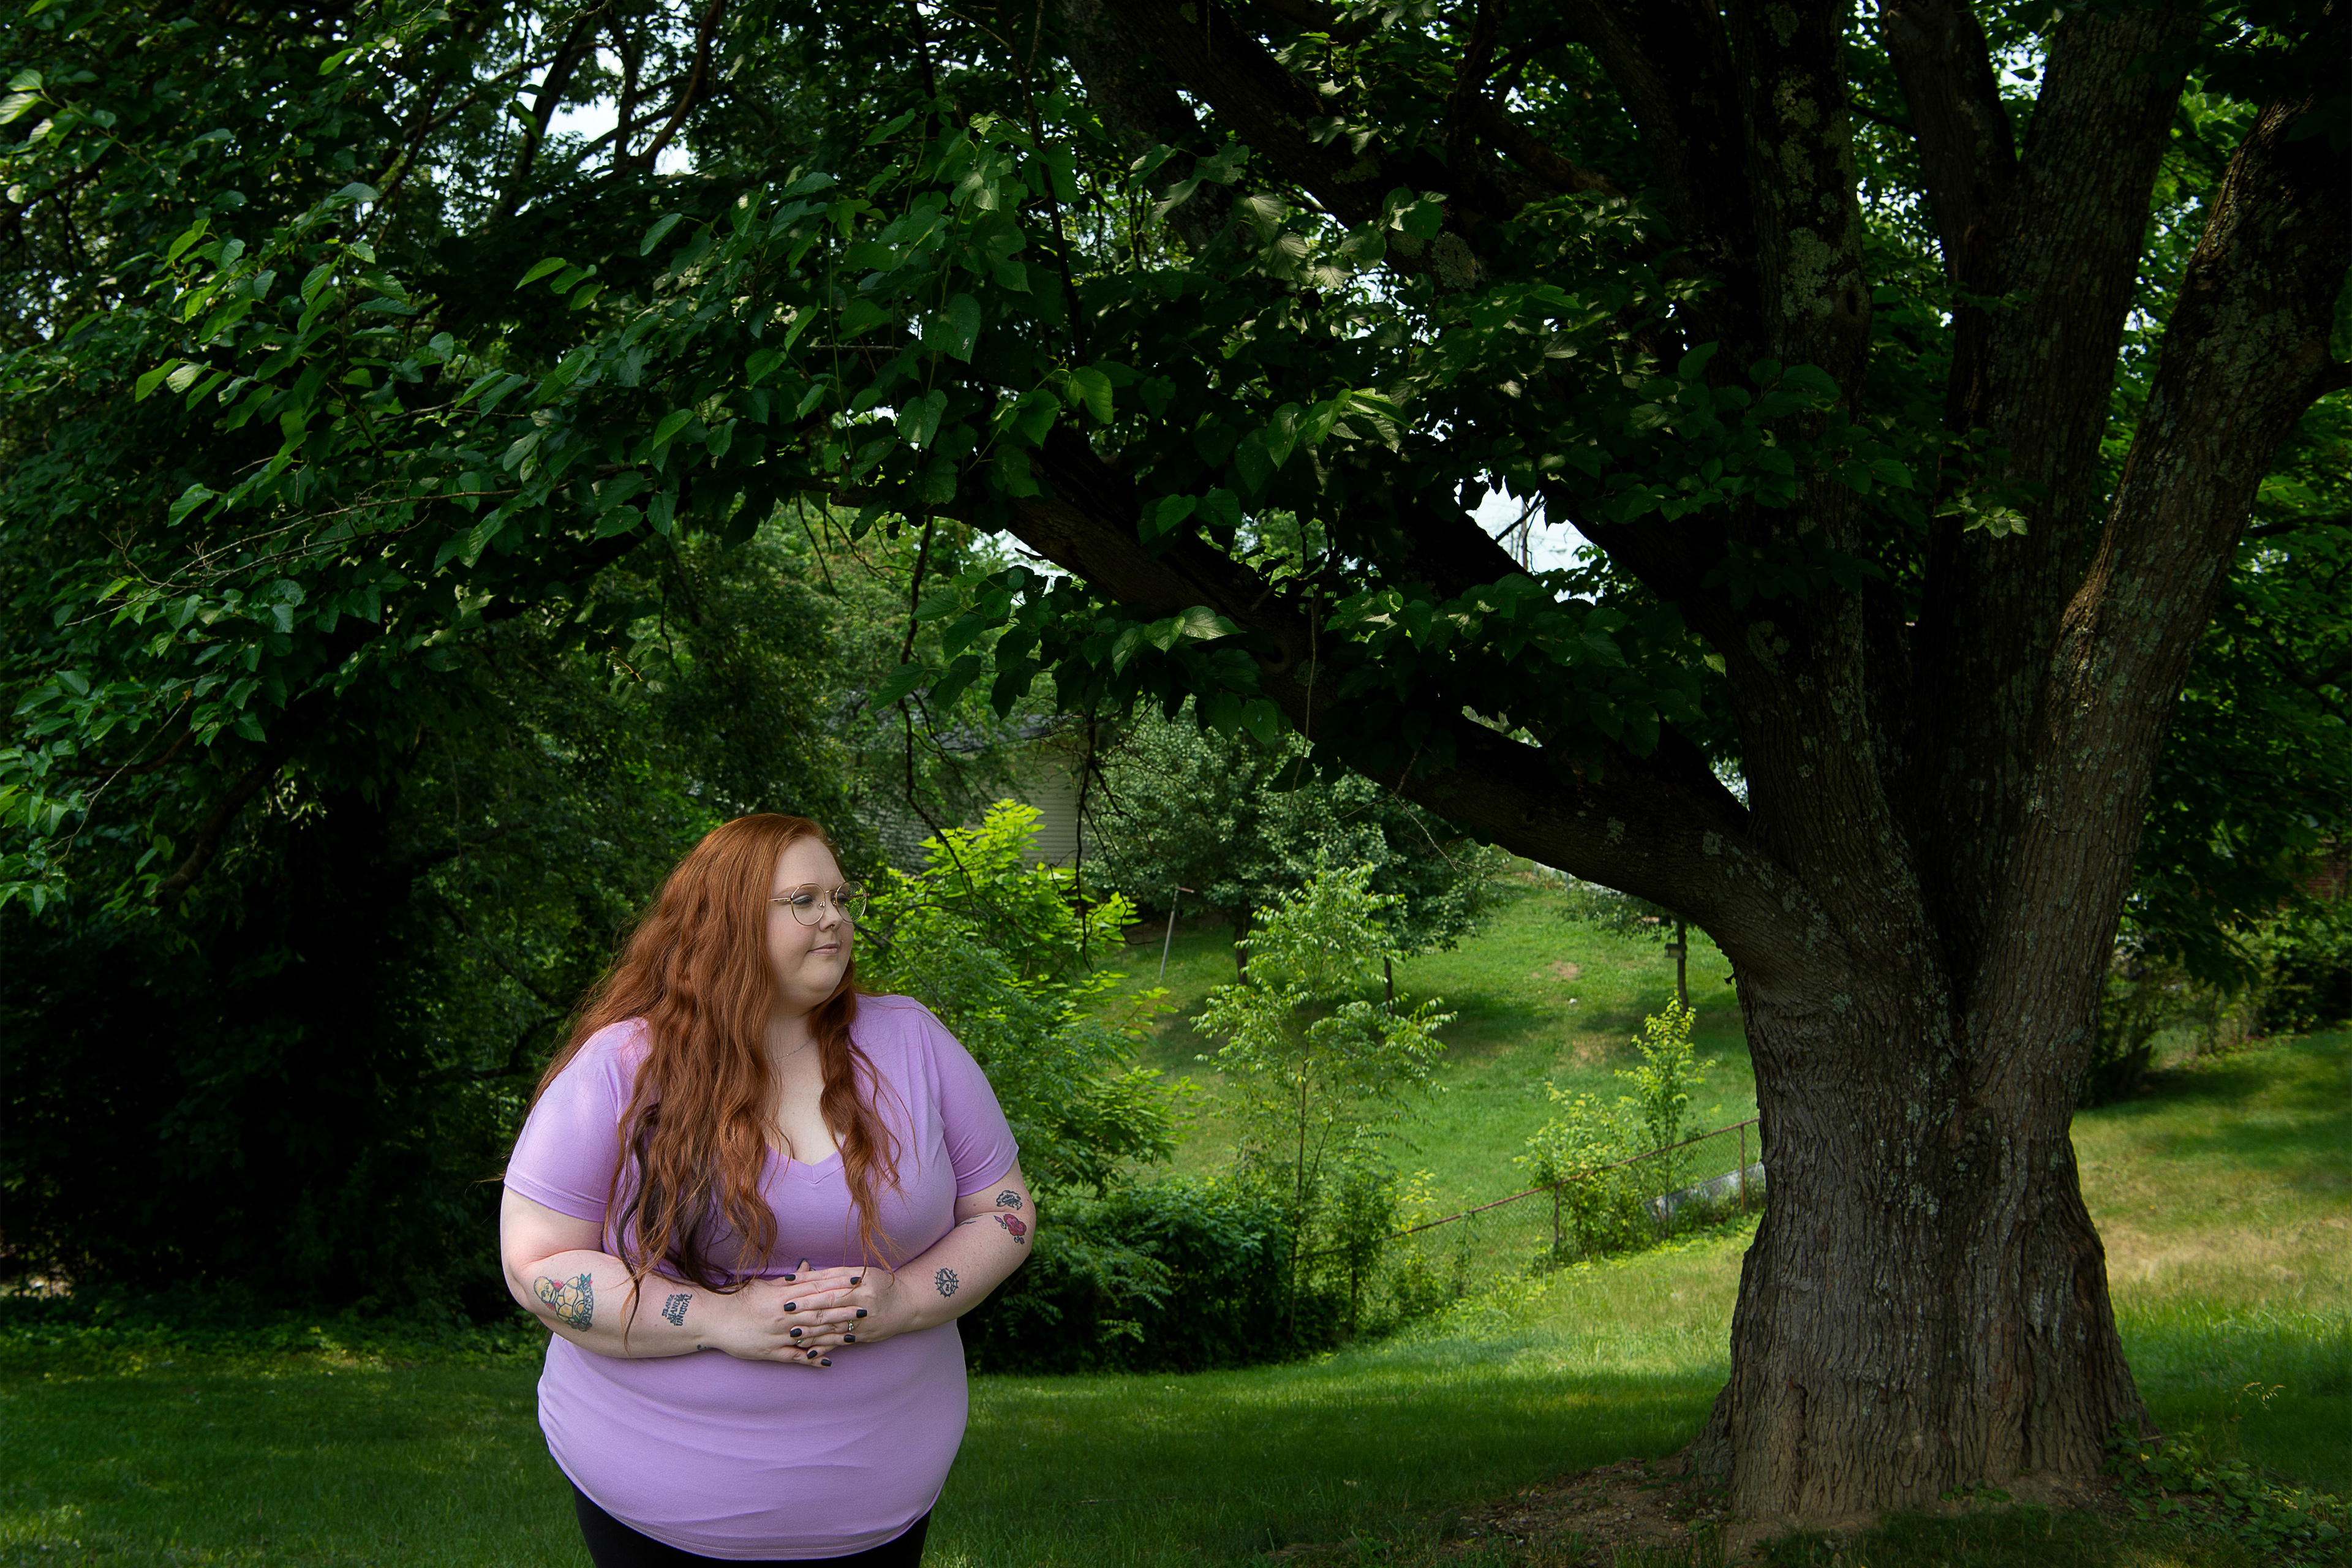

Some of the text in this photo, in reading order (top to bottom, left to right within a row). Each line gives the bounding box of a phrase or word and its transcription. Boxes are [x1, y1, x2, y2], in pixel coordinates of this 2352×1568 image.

[662, 1294, 674, 1317] STRANGE
[670, 1300, 680, 1315] AND
[676, 1294, 693, 1325] UNUSUAL
